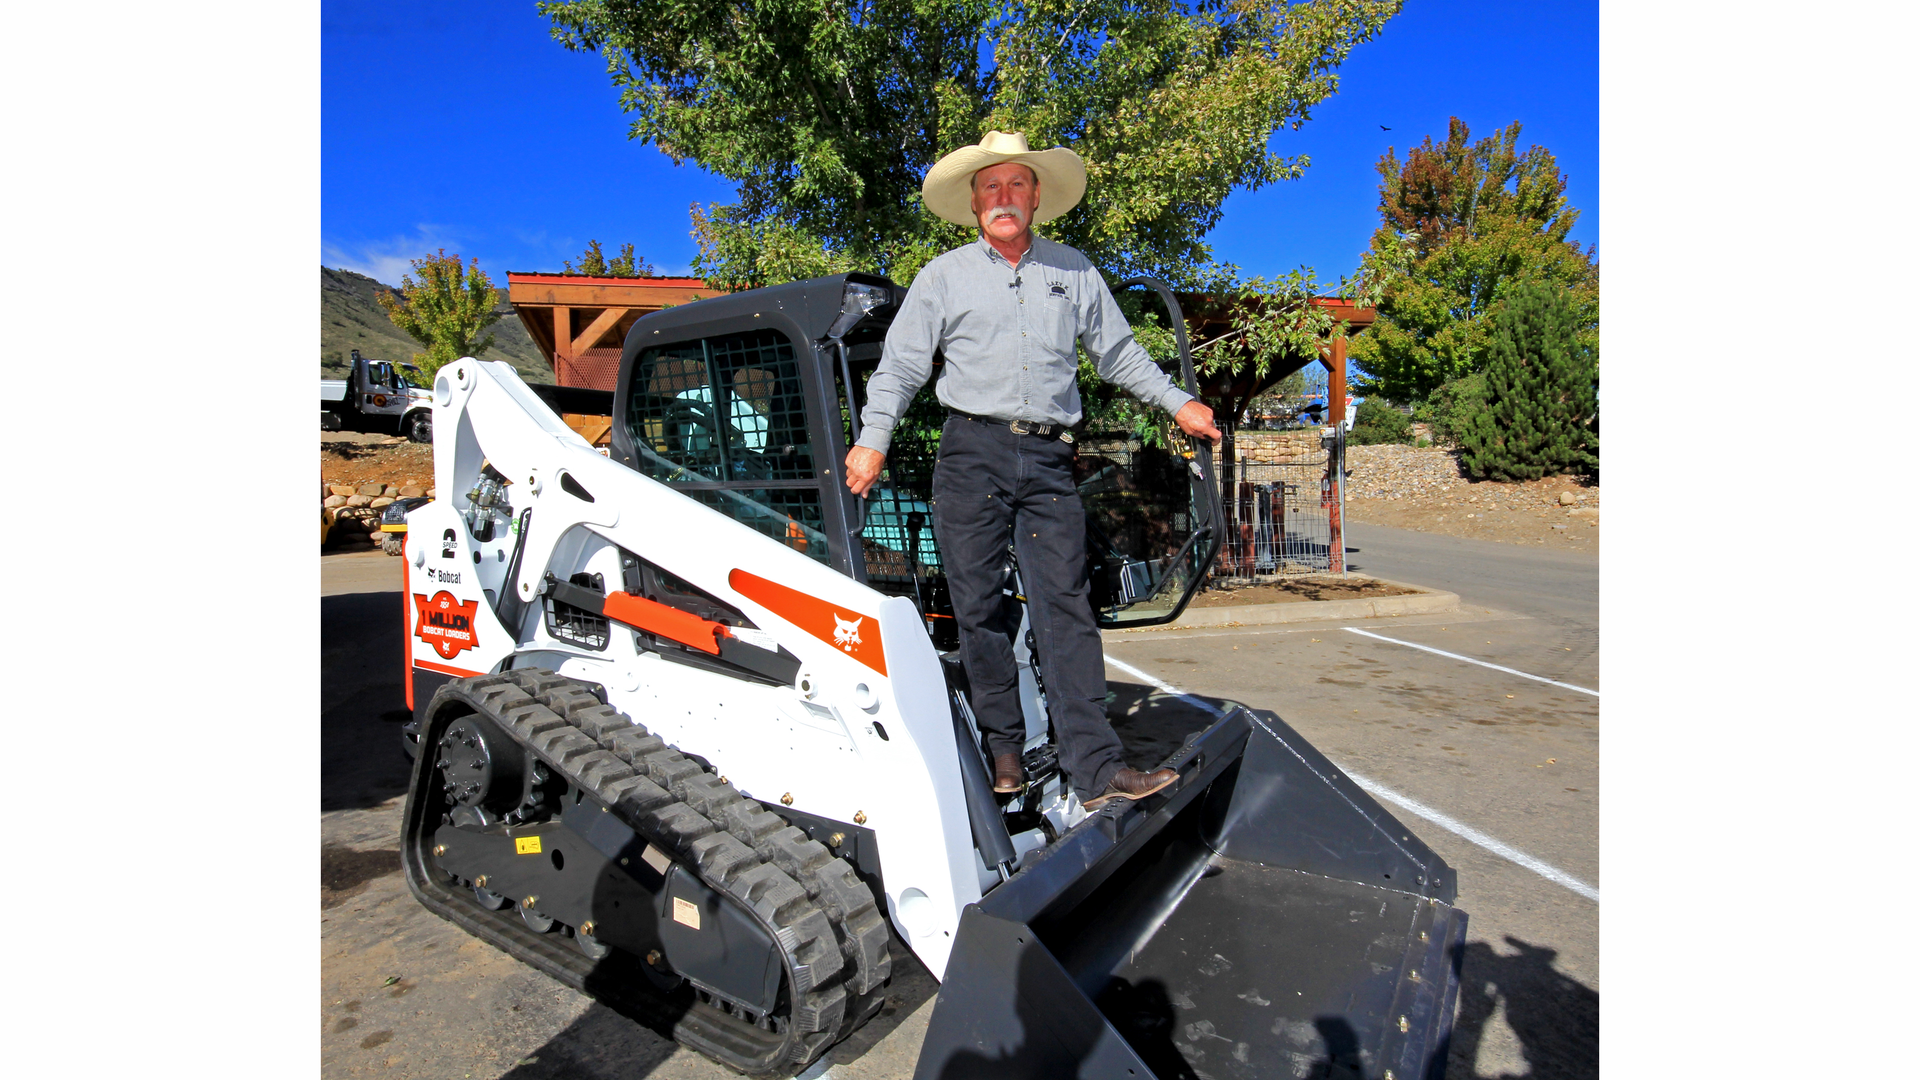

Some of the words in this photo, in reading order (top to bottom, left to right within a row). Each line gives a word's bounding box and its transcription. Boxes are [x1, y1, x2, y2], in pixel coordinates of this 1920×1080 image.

[442, 528, 456, 559] 2
[438, 570, 461, 584] Bobcat
[422, 610, 426, 625] 1
[429, 611, 469, 632] MILLION
[423, 625, 444, 636] BOBCAT
[445, 629, 470, 641] LOADERS
